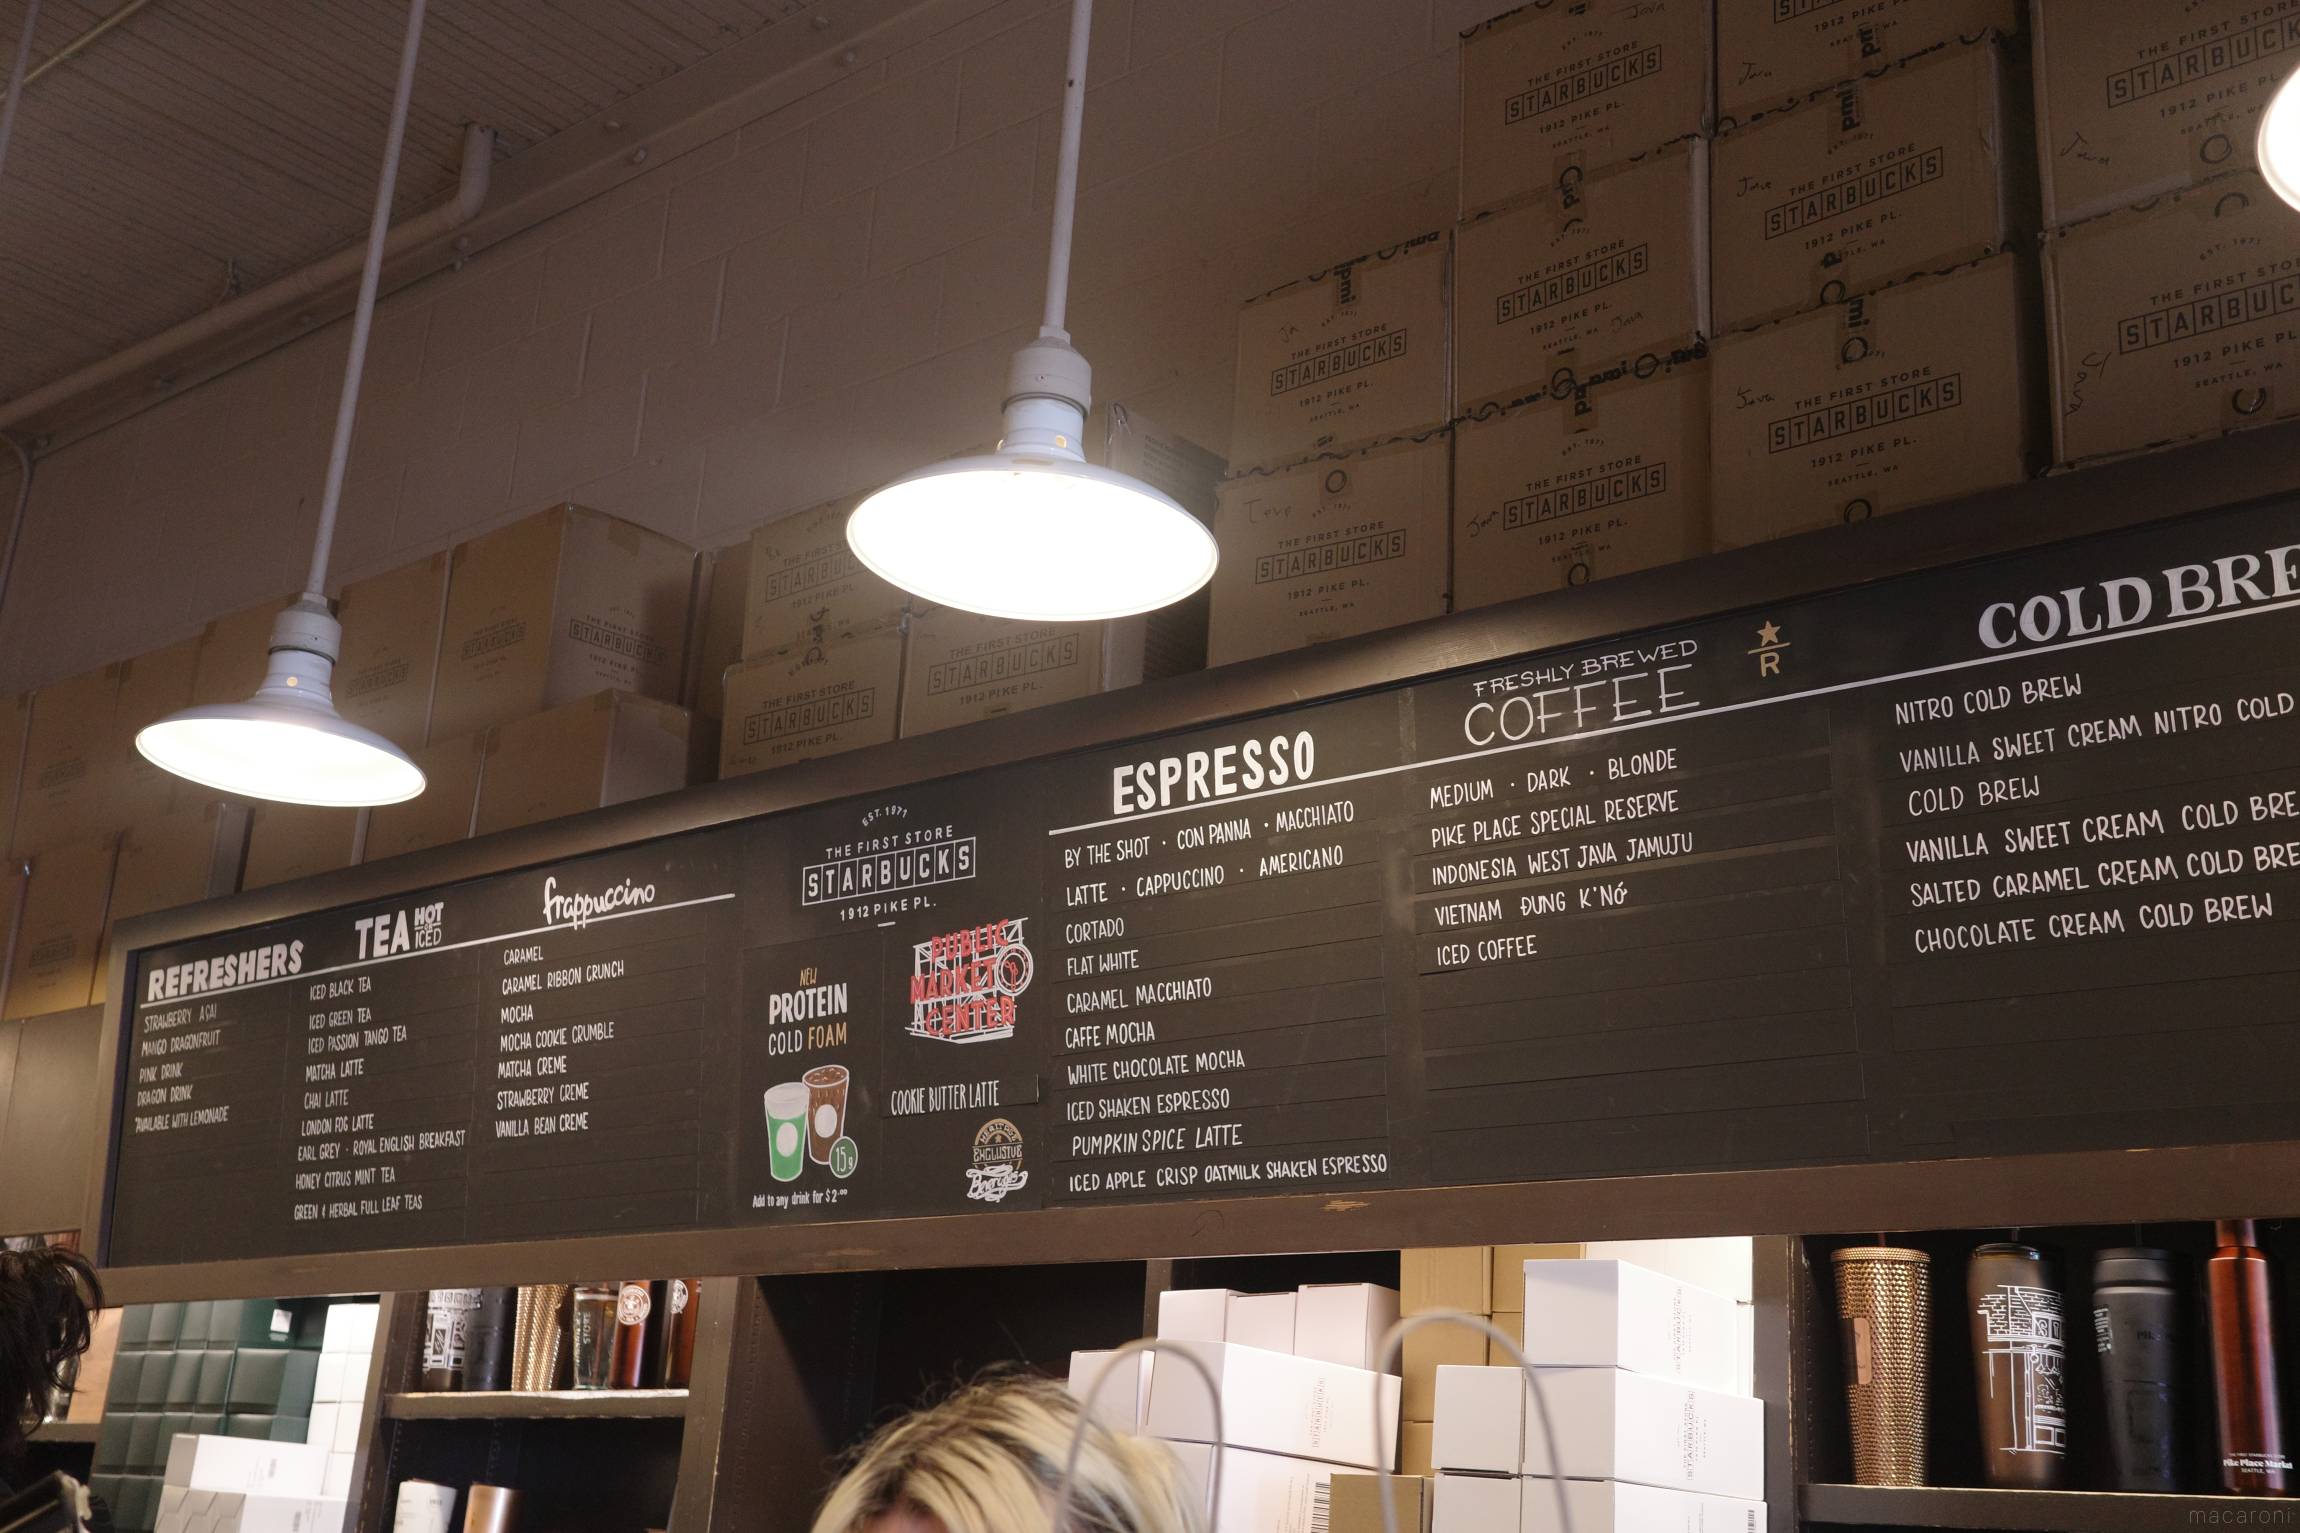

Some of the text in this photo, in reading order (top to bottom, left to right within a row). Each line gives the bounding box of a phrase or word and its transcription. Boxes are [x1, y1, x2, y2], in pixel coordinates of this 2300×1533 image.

[1527, 41, 1639, 87] THE FIRST STORE
[2114, 17, 2300, 99] STARBUCK
[1509, 52, 1657, 118] STARBUCKS
[1540, 120, 1565, 134] 1912
[1571, 108, 1600, 124] PIKE
[1770, 156, 1937, 231] STARBUCKS
[1502, 251, 1643, 317] STARBUCKS
[1275, 336, 1402, 391] STARBUCKS
[1795, 367, 1932, 410] THE FIRST STORE
[1775, 382, 1955, 446] STARBUCKS
[1811, 453, 1843, 467] 1912
[1850, 442, 1885, 459] PIKE
[1508, 470, 1660, 523] STARBUCKS
[1260, 536, 1401, 578] STARBUCKS
[1288, 588, 1312, 600] 1912
[1318, 582, 1345, 594] PIKE
[1978, 543, 2300, 649] COLD BRE
[933, 642, 1073, 689] STARBUCKS
[1473, 639, 1698, 698] FRESHLY BREWED
[748, 695, 869, 739] STARBUCKS
[1464, 663, 1700, 746] COFFEE
[1895, 673, 2082, 726] NITRO COLD BREW
[1899, 692, 2295, 773] VANILLA SWEET CREAM NITRO COLD
[1113, 731, 1314, 815] ESPRESSO
[1430, 748, 1678, 809] MEDIUM DARK BLONDE
[1908, 775, 2040, 816] COLD BREW
[1065, 801, 1354, 868] BY THE SHOT CON PANNA MACCHIATO
[1431, 789, 1680, 849] PIKE PLACE SPECIAL RESERVE
[1906, 790, 2300, 863] VANILLA SWEET CREAM COLD BRE
[826, 825, 953, 859] THE FIRST STORE
[1432, 831, 1693, 886] INDONESIA WEST JAVA JAMUJU
[808, 844, 970, 898] STARBUCKS
[1067, 845, 1343, 907] LATTE CAPPUCCINO AMERICANO
[414, 902, 444, 925] HOT
[543, 876, 655, 930] frappuccino
[840, 896, 936, 922] 1912 PIKE PL.
[1915, 892, 2273, 954] CHOCOLATE CREAM COLD BREW
[355, 911, 410, 960] TEA
[414, 929, 441, 949] ICED
[932, 918, 1009, 963] PUBLIC
[1066, 917, 1124, 944] CORTADO
[1437, 935, 1537, 966] ICED COFFEE
[148, 940, 304, 1001] REFRESHERS
[504, 946, 544, 966] CARAMEL
[1067, 949, 1139, 976] FLAT WHITE
[310, 976, 371, 1000] ICED BLACK TEA
[502, 960, 624, 995] CARAMEL RIBBON CRUNCH
[800, 968, 817, 986] NEW
[910, 957, 998, 1004] MARKET
[1067, 977, 1212, 1014] CARAMEL MACCHIATO
[309, 1008, 372, 1030] ICED GREEN TEA
[501, 1004, 534, 1024] MOCHA
[769, 983, 848, 1025] PROTEIN
[926, 996, 1016, 1036] CENTER
[768, 1022, 847, 1056] COLD FOAM
[1066, 1021, 1155, 1048] CAFFE MOCHA
[139, 1062, 183, 1083] PINK DRINK
[305, 1059, 364, 1082] MATCHA LATTE
[498, 1056, 567, 1079] MATCHA CREME
[137, 1085, 193, 1107] DRAGON DRINK
[304, 1089, 349, 1110] CHAI LATTE
[891, 1080, 999, 1116] COOKIE BUTTER LATTE
[1067, 1088, 1230, 1121] ICED SHAKEN ESPRESSO
[301, 1114, 374, 1136] LONDON FOG LATTE
[496, 1112, 589, 1138] VANILLA BEAN CREME
[1072, 1124, 1243, 1156] PUMPKIN SPICE LATTE
[295, 1167, 395, 1190] HONEY CITRUS MINT TEA
[1070, 1153, 1387, 1192] ICED APPLE CRISP OATMILK SHAKEN ESPRESSO
